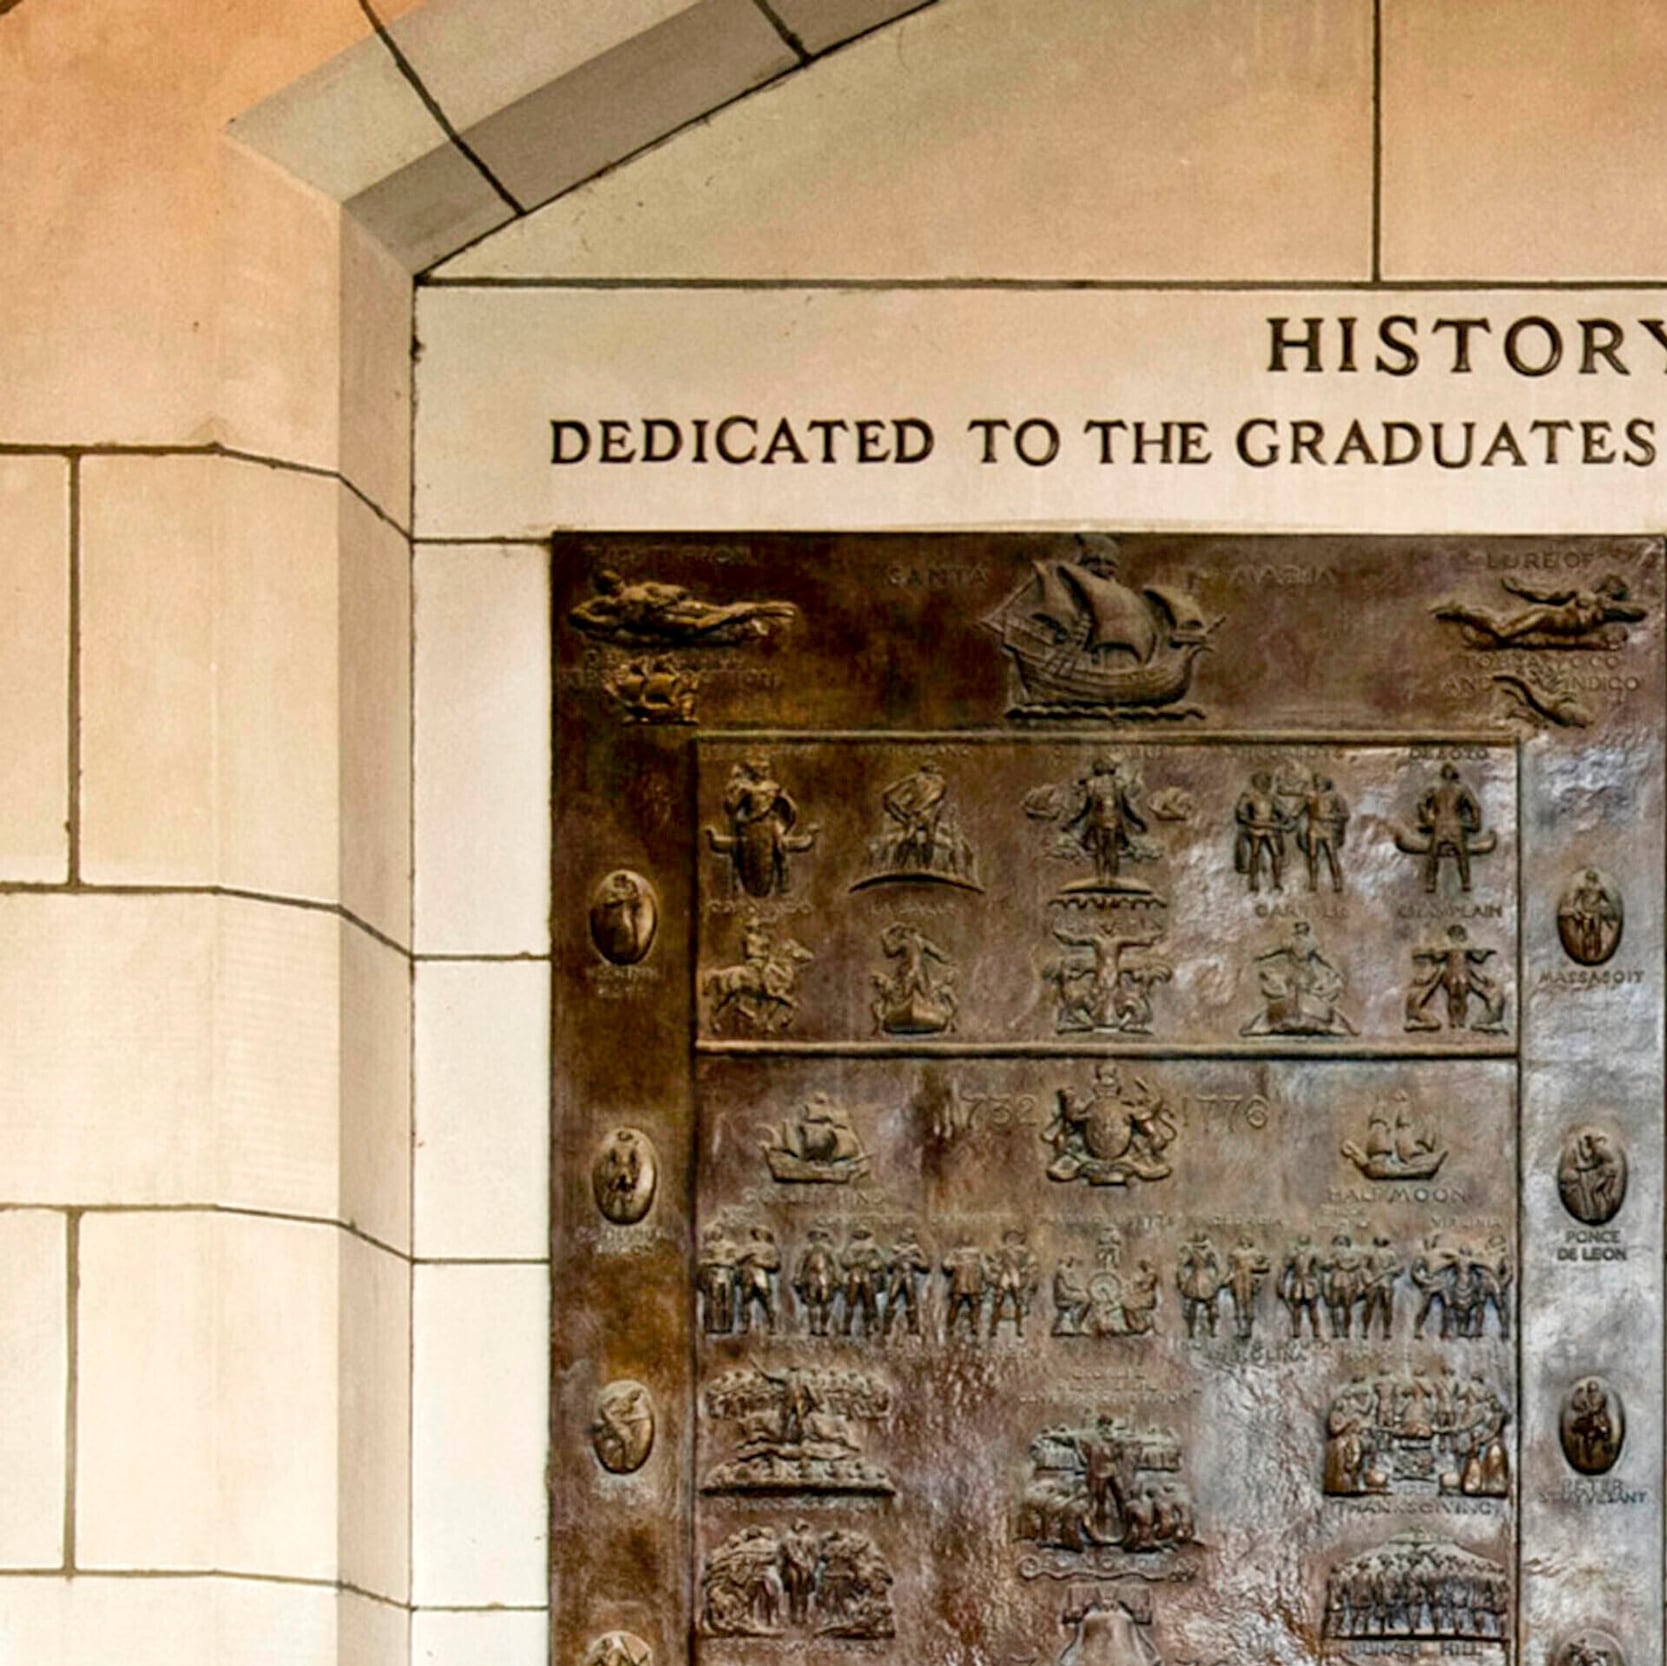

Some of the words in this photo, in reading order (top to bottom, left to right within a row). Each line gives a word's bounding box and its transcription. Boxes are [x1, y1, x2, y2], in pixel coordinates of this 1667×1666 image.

[549, 416, 935, 466] DEDICATED
[967, 417, 1061, 467] TO
[1083, 419, 1213, 465] THE
[1235, 417, 1657, 470] GRADUATES
[1487, 551, 1557, 570] LURE
[1538, 968, 1647, 985] MASSASOIT
[1388, 1186, 1467, 1204] MOON
[1565, 1230, 1622, 1244] PONCE
[1556, 1248, 1578, 1262] DE
[1582, 1248, 1629, 1262] LEON
